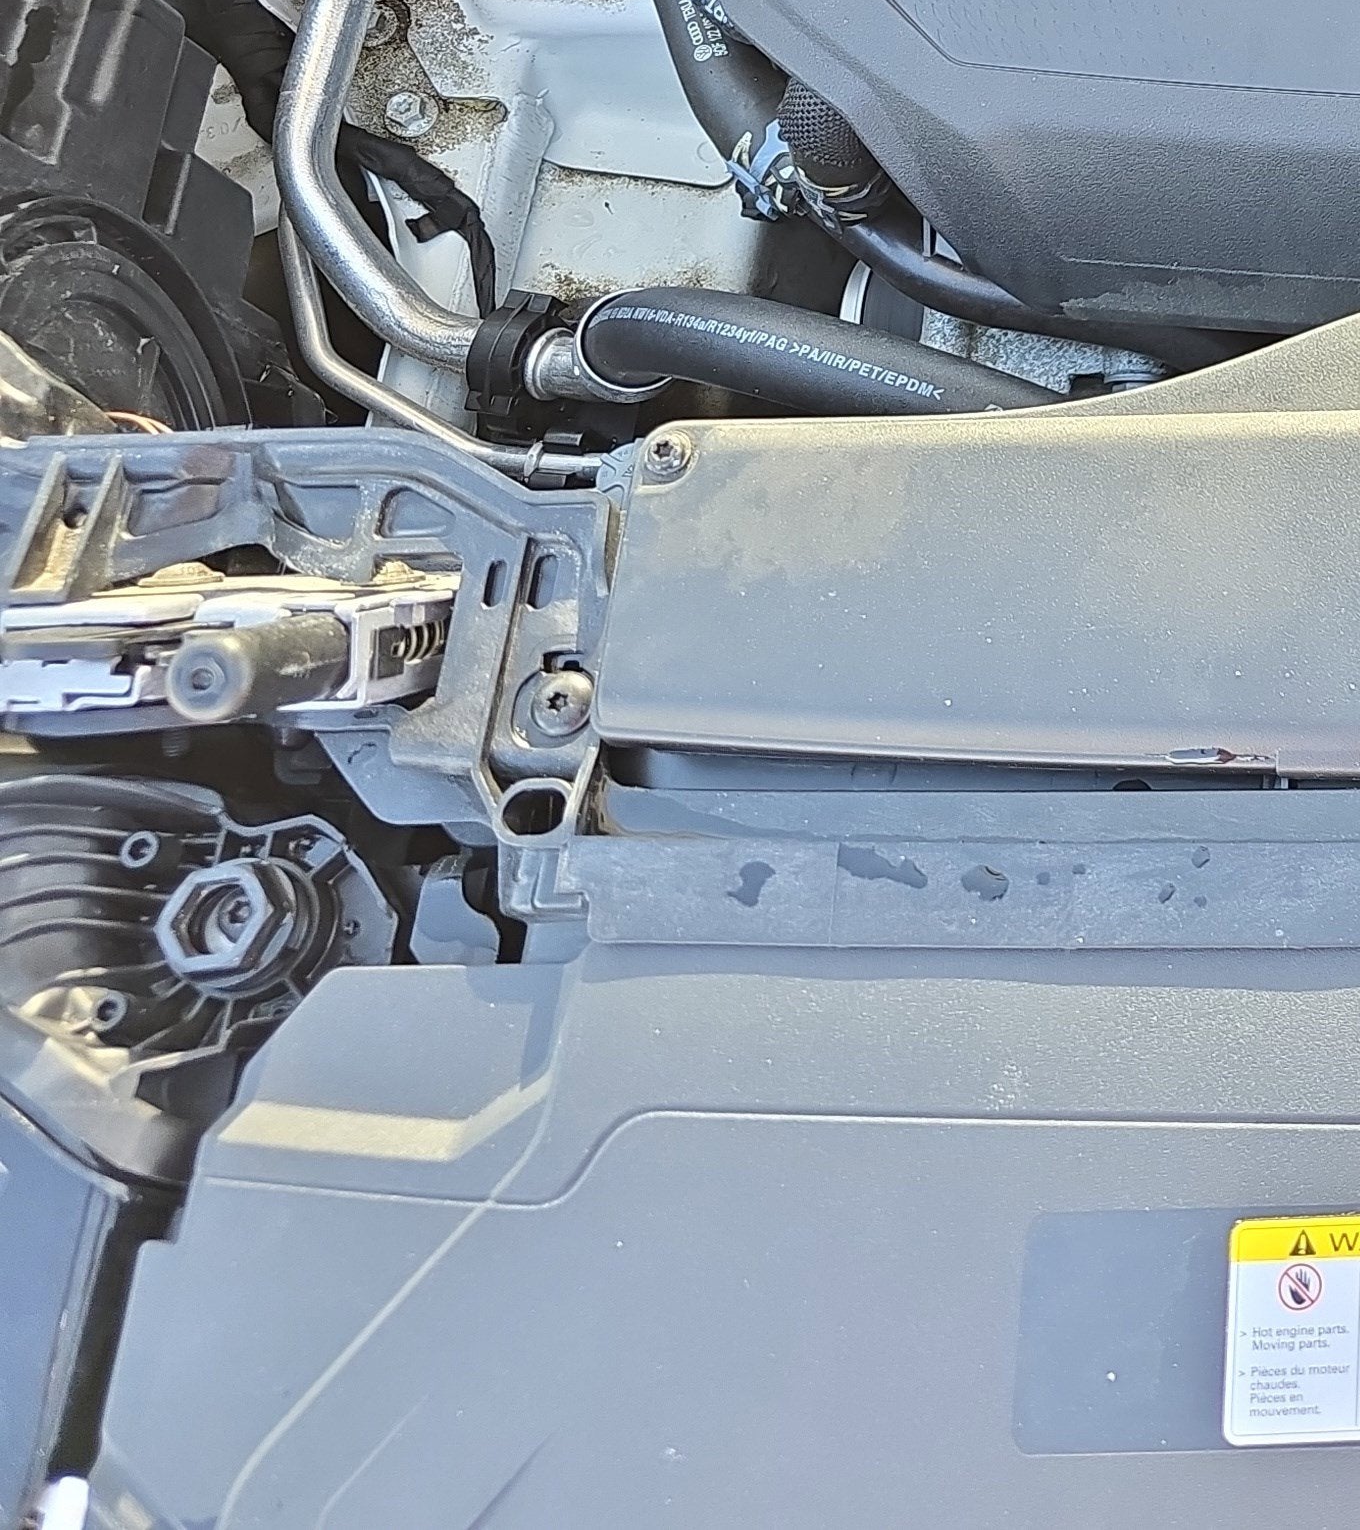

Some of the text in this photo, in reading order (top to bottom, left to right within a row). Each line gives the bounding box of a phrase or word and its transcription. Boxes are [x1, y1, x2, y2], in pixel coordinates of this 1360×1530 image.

[1253, 1324, 1349, 1339] Hot engine parts.
[1253, 1339, 1330, 1351] Moving parts.
[1250, 1364, 1349, 1376] Pièces du moteur
[1250, 1379, 1299, 1390] chaudes.
[1250, 1393, 1303, 1403] Pièces en
[1250, 1404, 1321, 1417] mouvement.
